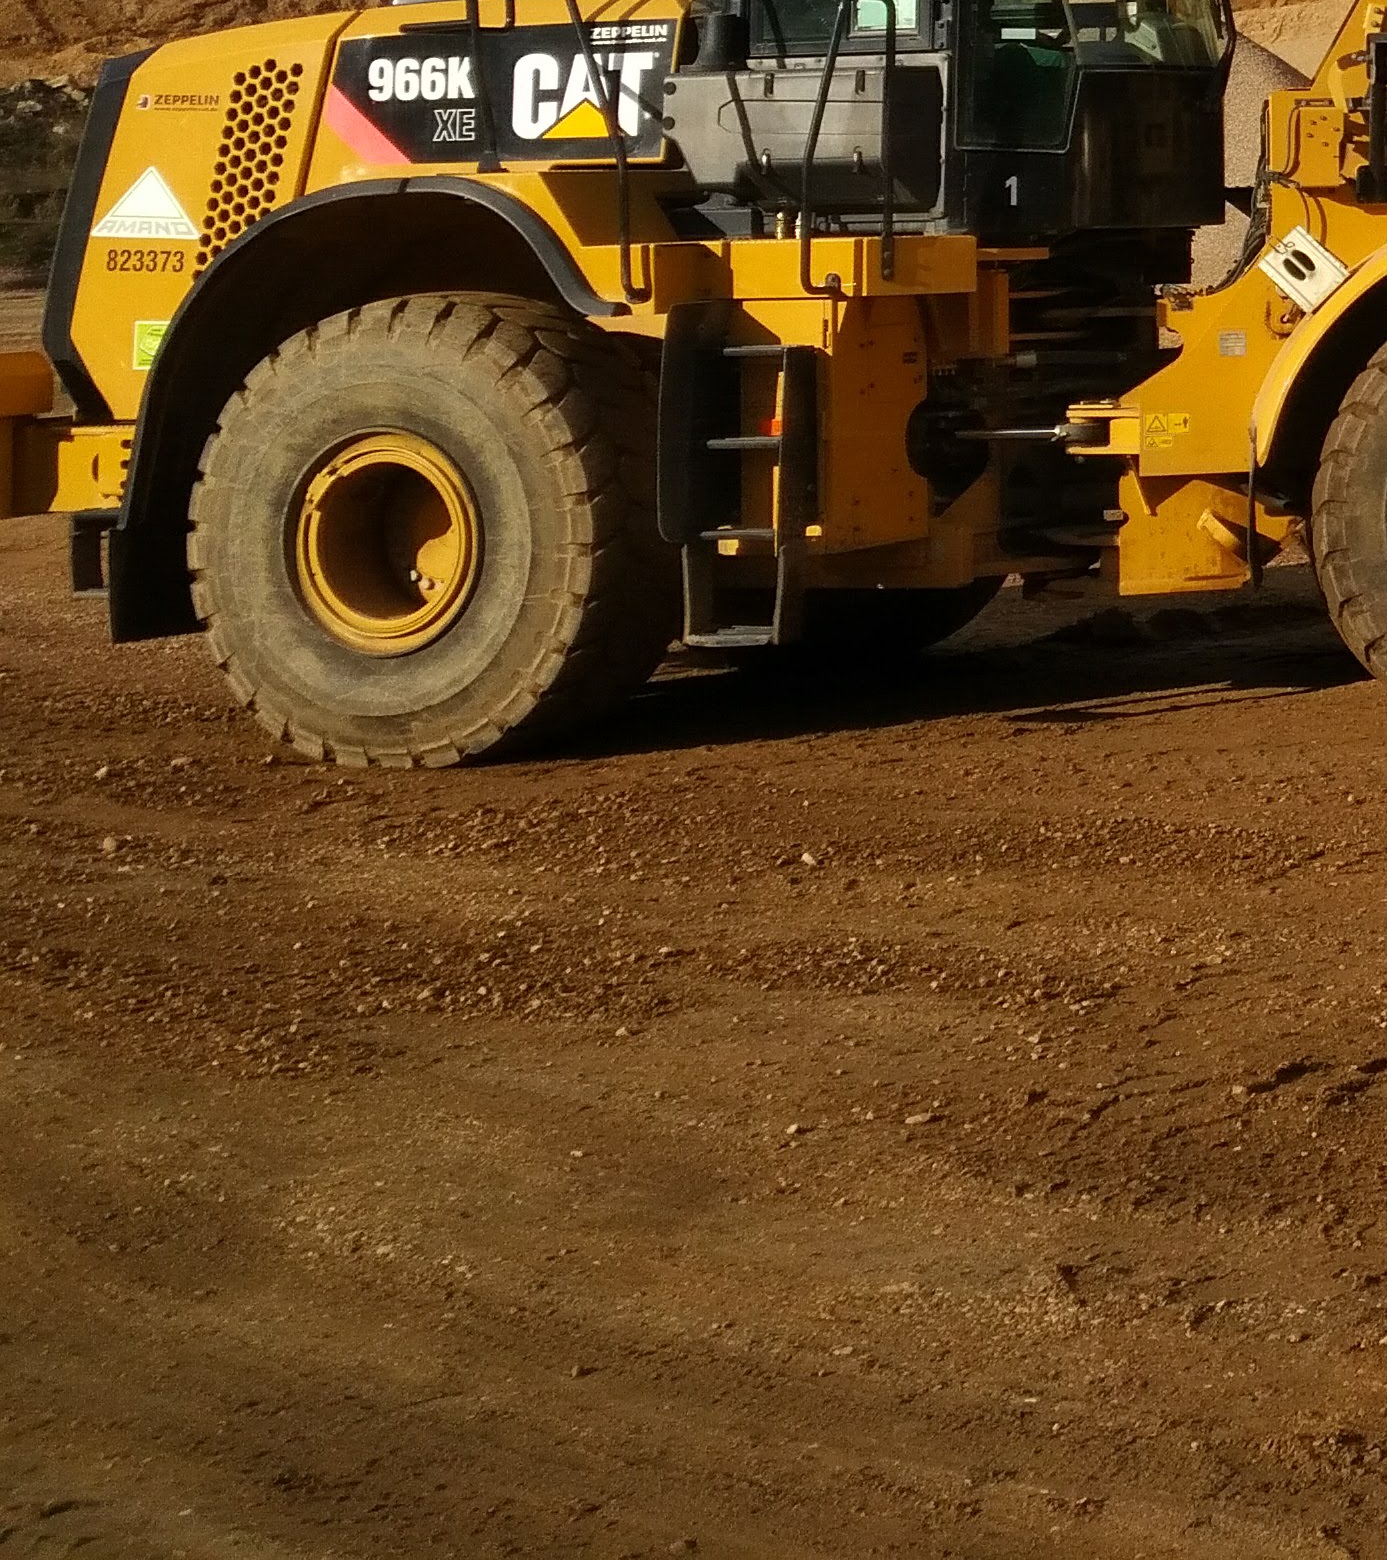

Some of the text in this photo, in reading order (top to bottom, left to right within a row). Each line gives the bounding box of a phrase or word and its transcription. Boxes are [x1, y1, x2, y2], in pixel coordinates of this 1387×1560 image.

[590, 24, 668, 39] ZEPPELIN
[368, 56, 475, 102] 966K
[153, 94, 220, 106] ZEPPELIN
[511, 51, 654, 140] CAT
[432, 109, 475, 141] XE
[1004, 175, 1018, 206] 1
[96, 220, 195, 236] AMAND
[106, 248, 185, 272] 823373
